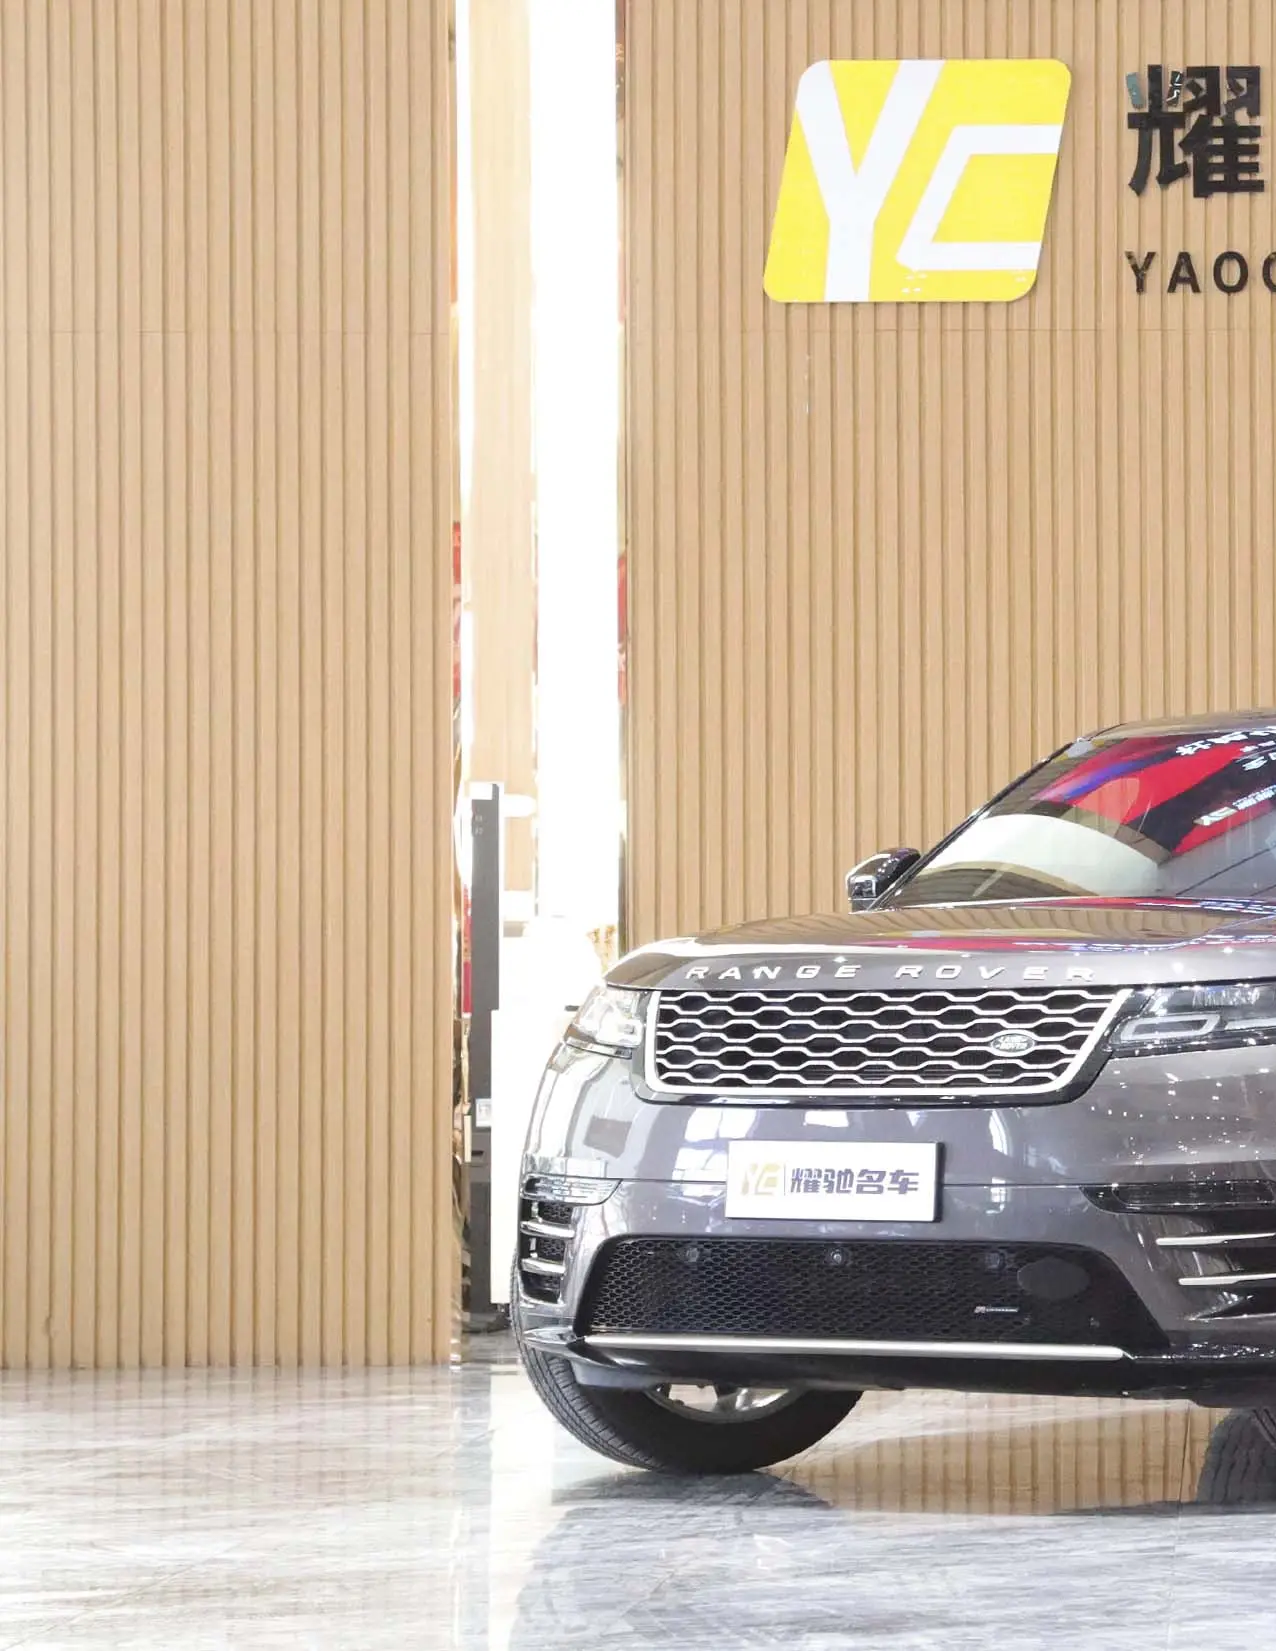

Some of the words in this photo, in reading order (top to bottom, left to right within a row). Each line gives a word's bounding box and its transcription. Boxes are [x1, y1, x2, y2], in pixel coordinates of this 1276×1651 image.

[684, 964, 862, 981] RANGE
[893, 964, 1096, 982] ROVER
[790, 1167, 920, 1194] 耀驰名车
